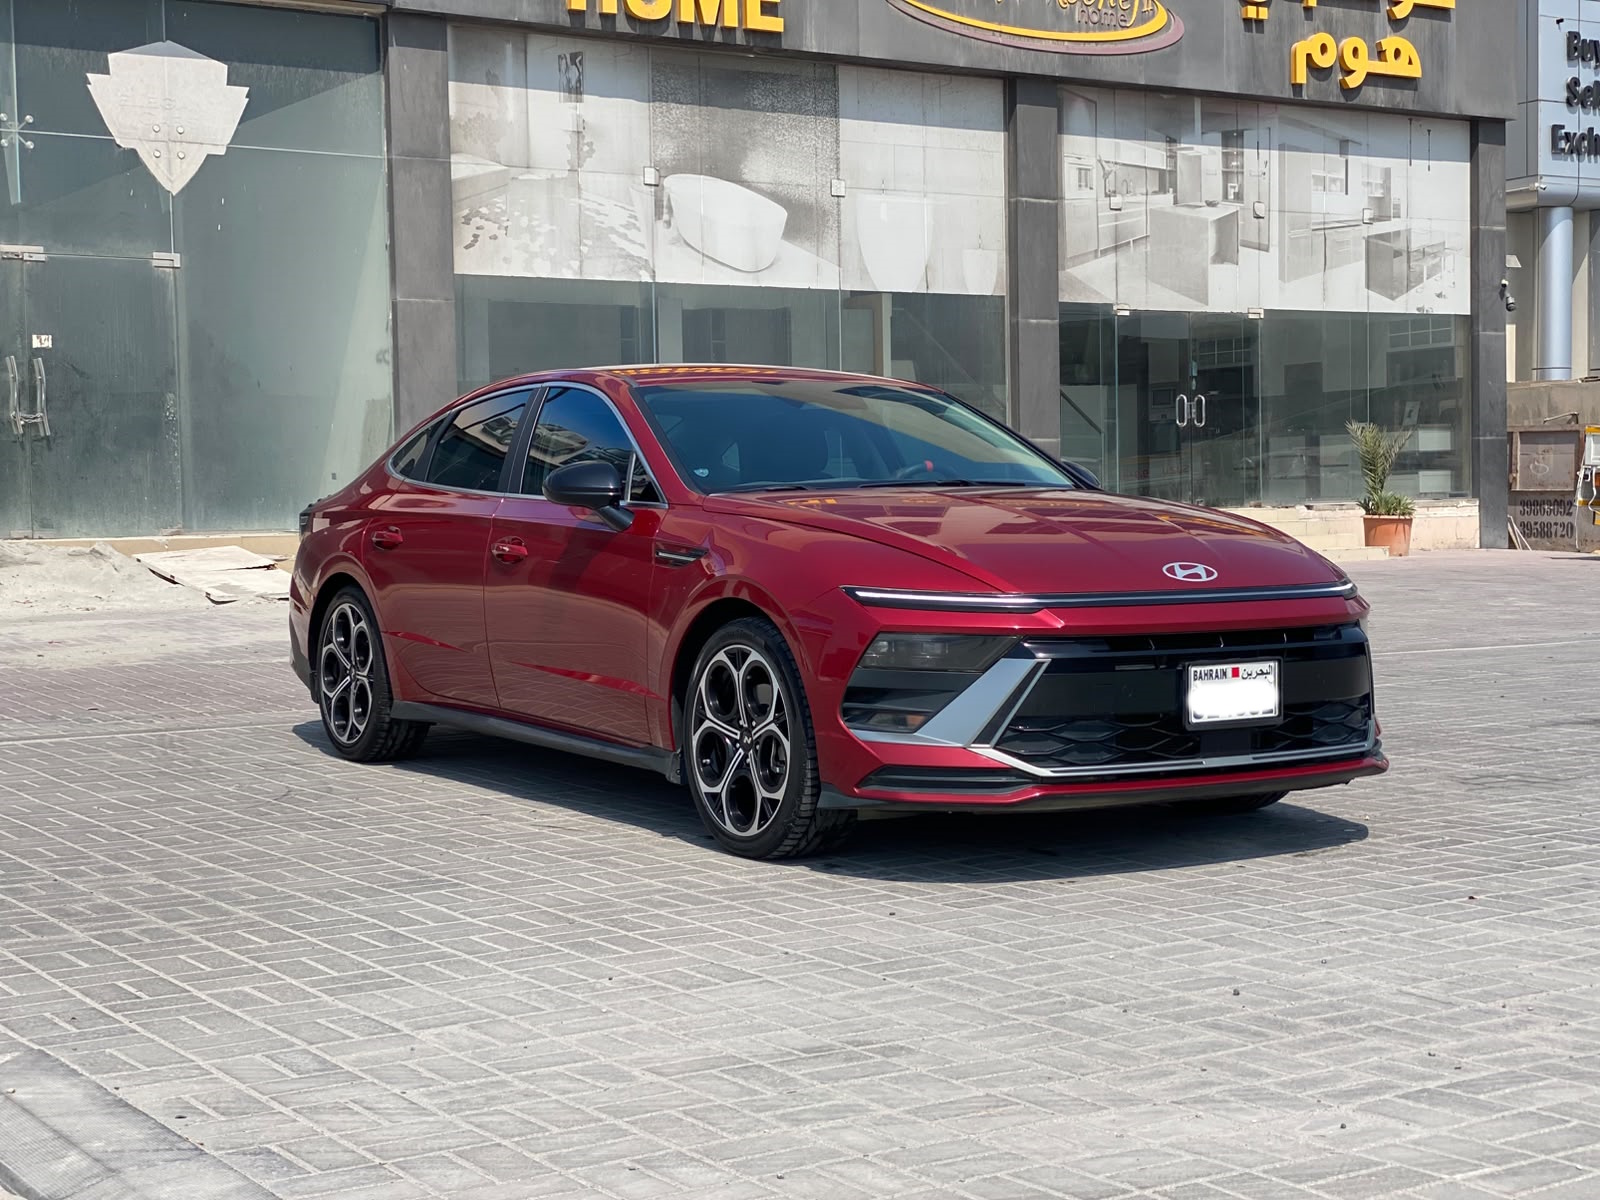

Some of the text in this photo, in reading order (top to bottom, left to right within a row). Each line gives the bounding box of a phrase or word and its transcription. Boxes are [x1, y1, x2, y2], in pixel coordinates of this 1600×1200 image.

[1077, 6, 1129, 28] home
[1291, 32, 1423, 89] هوم
[1519, 521, 1574, 539] 39588720
[1193, 668, 1227, 681] BAHRAIN
[1241, 664, 1273, 680] البحرين
